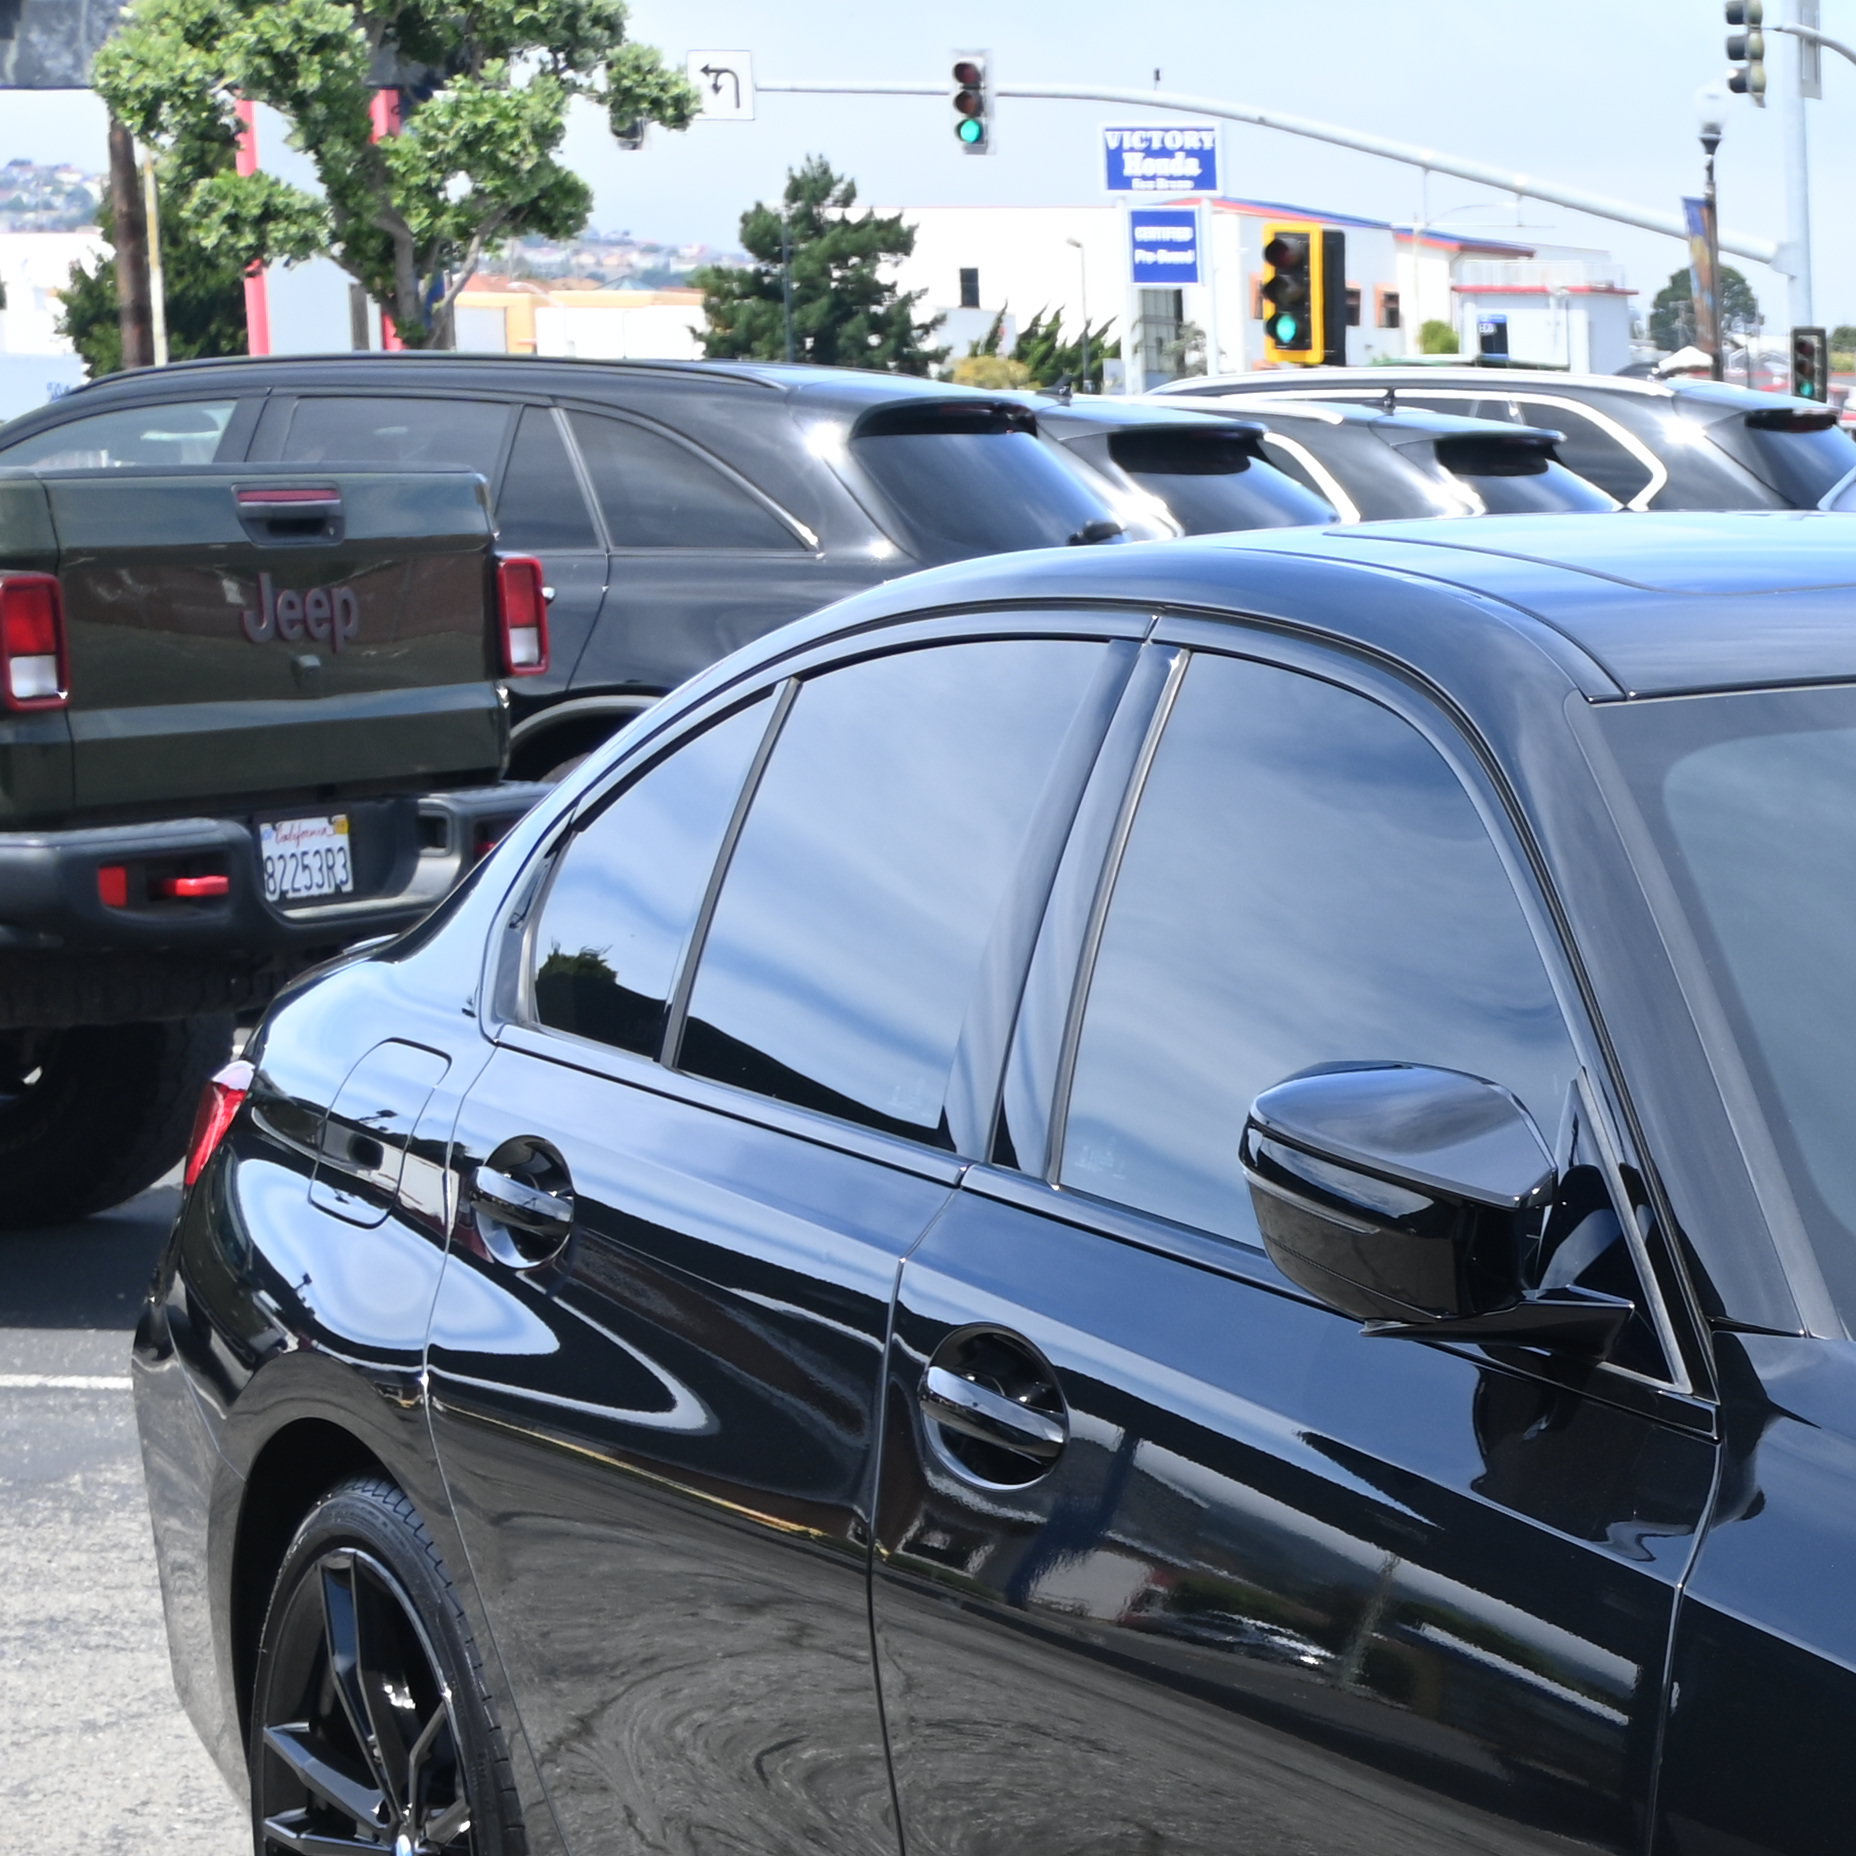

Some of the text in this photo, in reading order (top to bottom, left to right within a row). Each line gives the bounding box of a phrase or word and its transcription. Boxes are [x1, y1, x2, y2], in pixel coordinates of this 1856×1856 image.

[1104, 130, 1215, 150] VICTORY
[1122, 151, 1203, 177] Honda
[240, 571, 359, 654] Jeep
[264, 845, 349, 895] 82253R3
